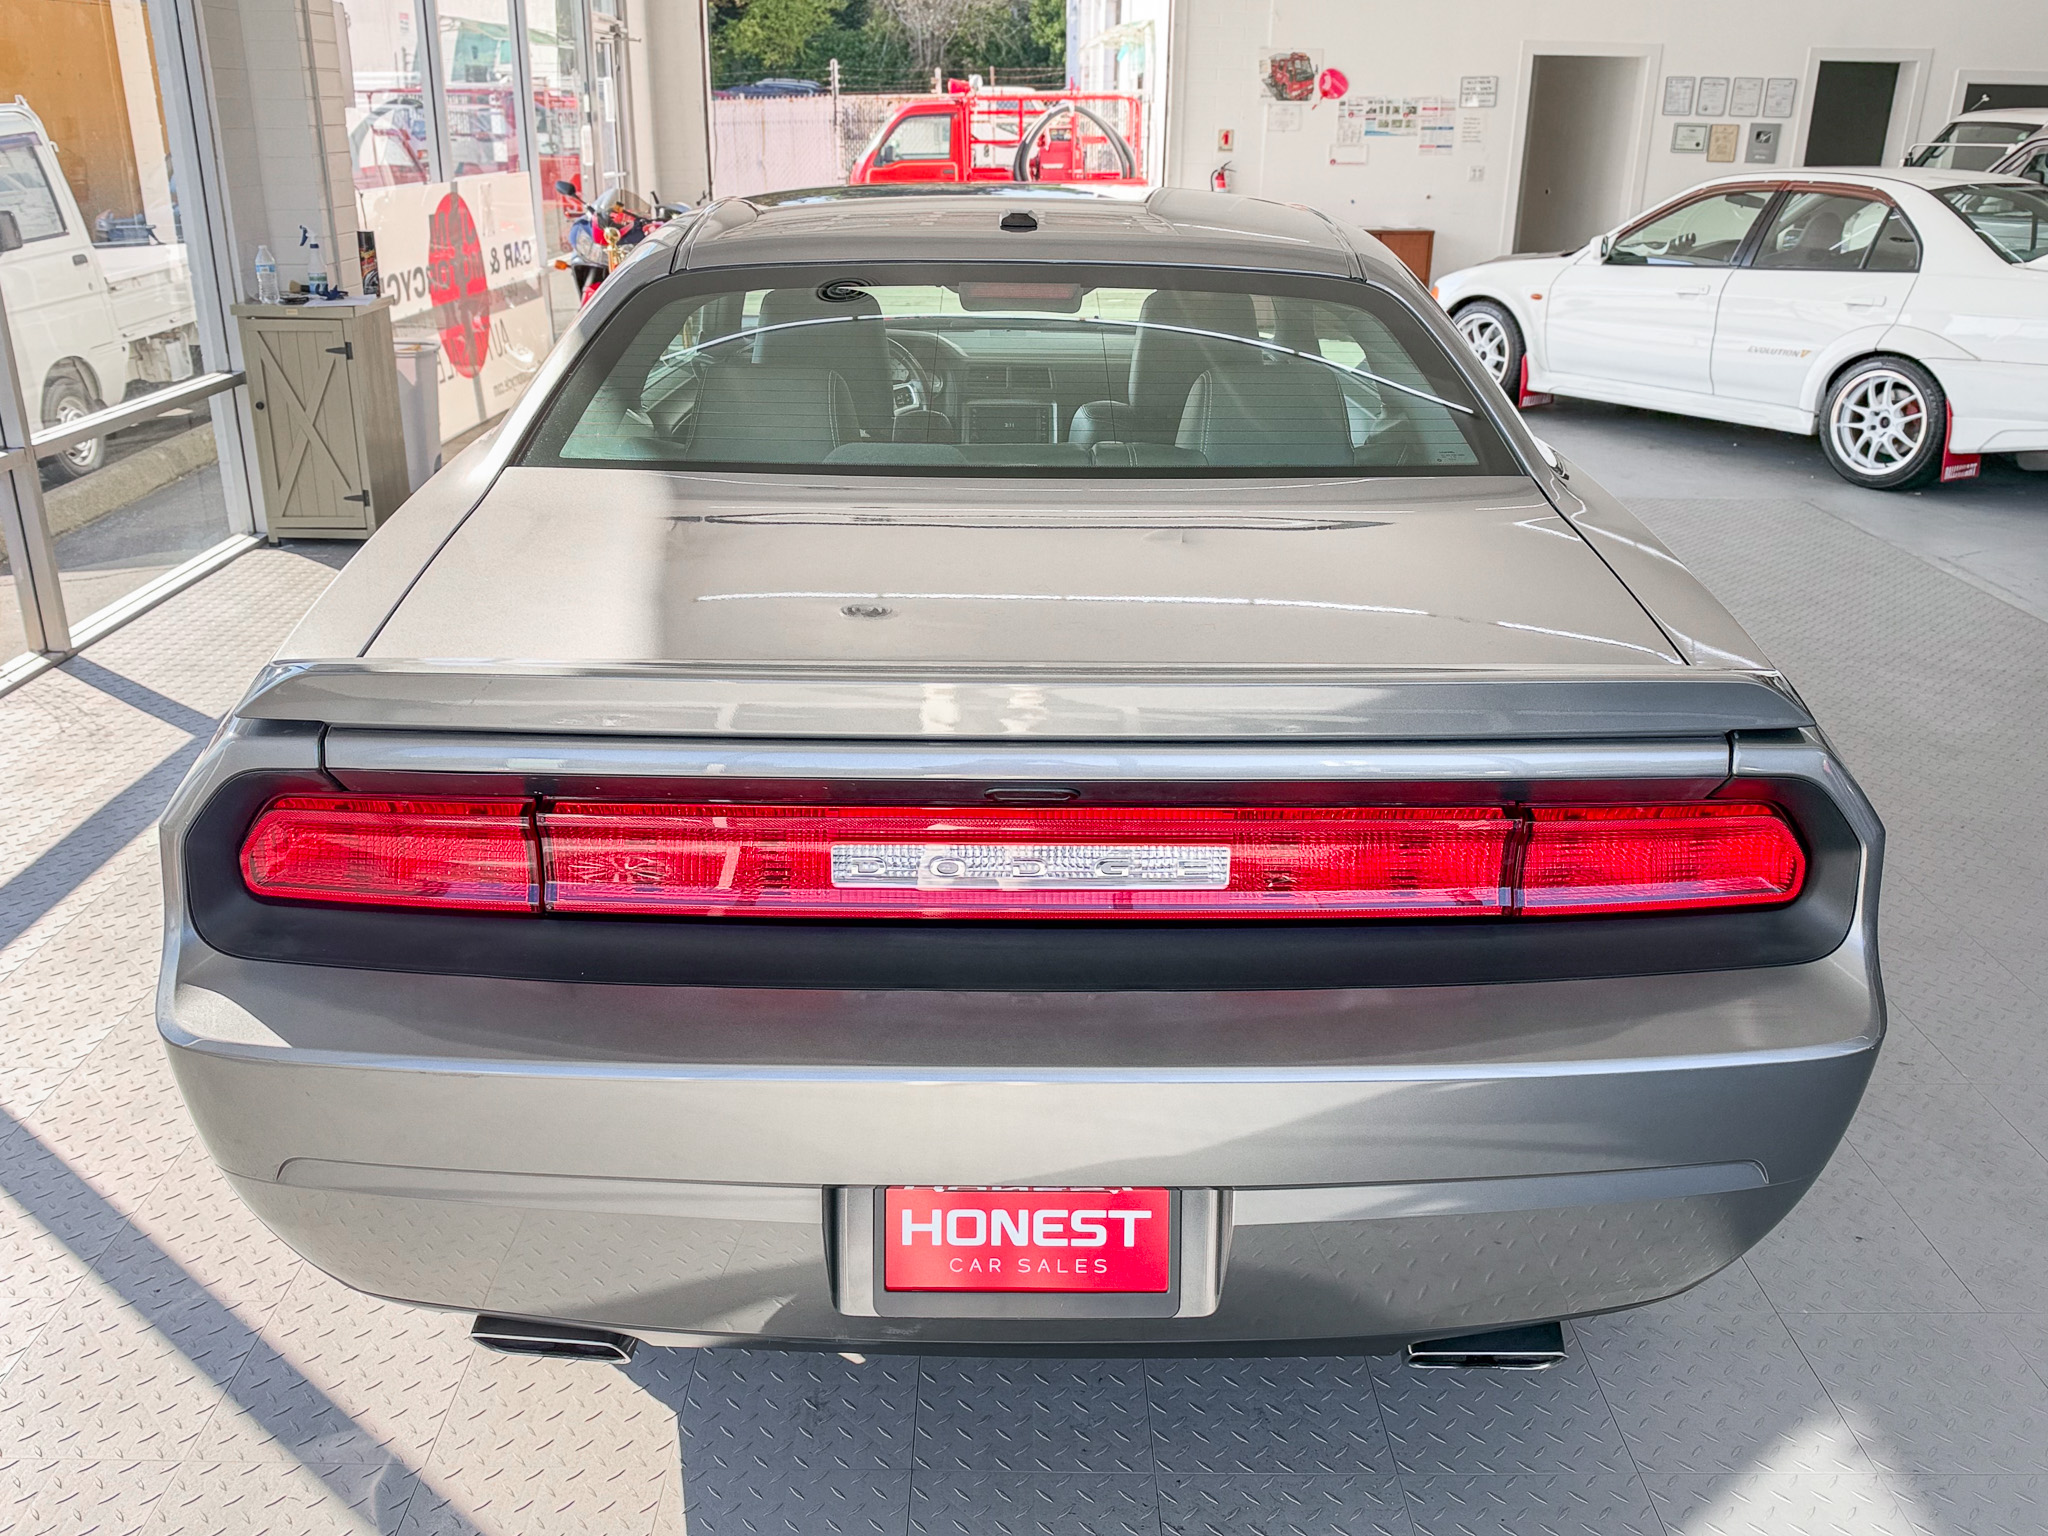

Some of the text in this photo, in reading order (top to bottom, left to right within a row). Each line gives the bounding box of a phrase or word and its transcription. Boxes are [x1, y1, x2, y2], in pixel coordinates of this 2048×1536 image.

[851, 855, 1212, 877] DODGE
[901, 1208, 1152, 1247] HONEST
[949, 1257, 1108, 1274] CAR SALES
